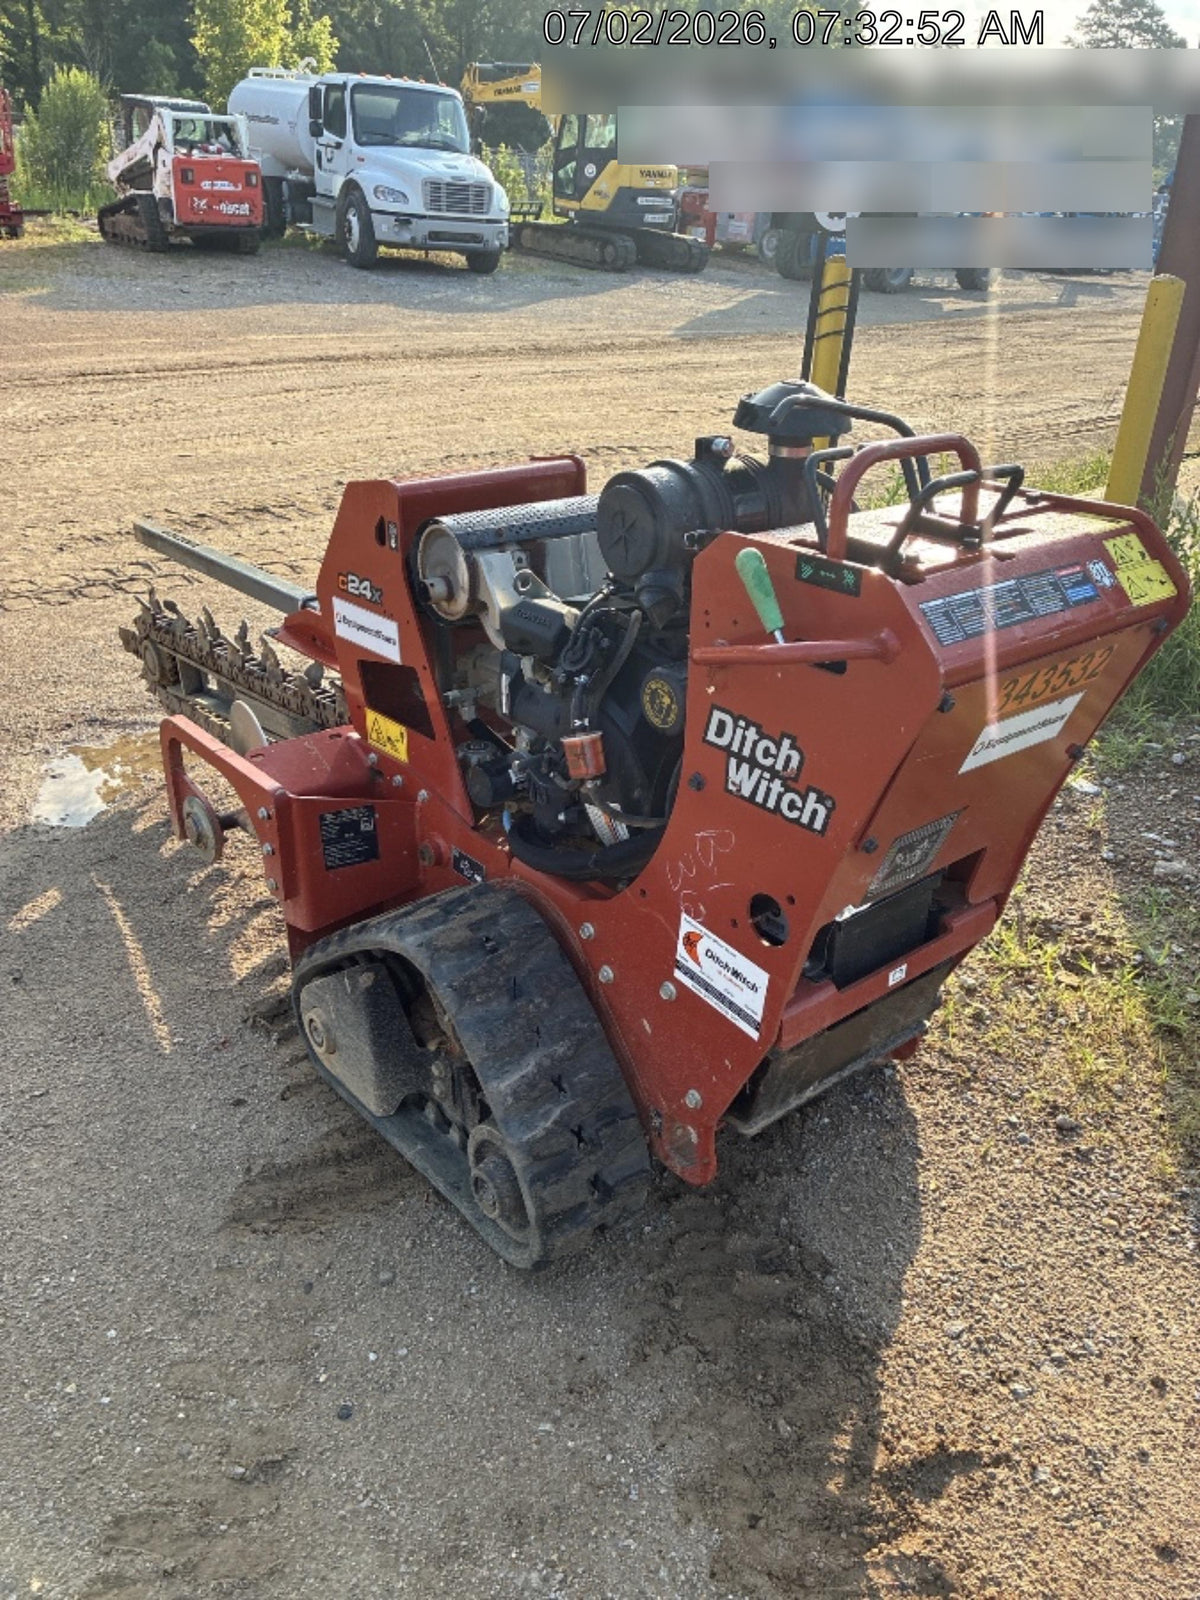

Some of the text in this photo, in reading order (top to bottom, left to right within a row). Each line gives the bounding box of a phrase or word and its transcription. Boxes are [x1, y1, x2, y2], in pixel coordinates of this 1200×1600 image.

[998, 644, 1117, 714] 343532
[706, 708, 801, 774] Ditch
[727, 756, 828, 831] Witch
